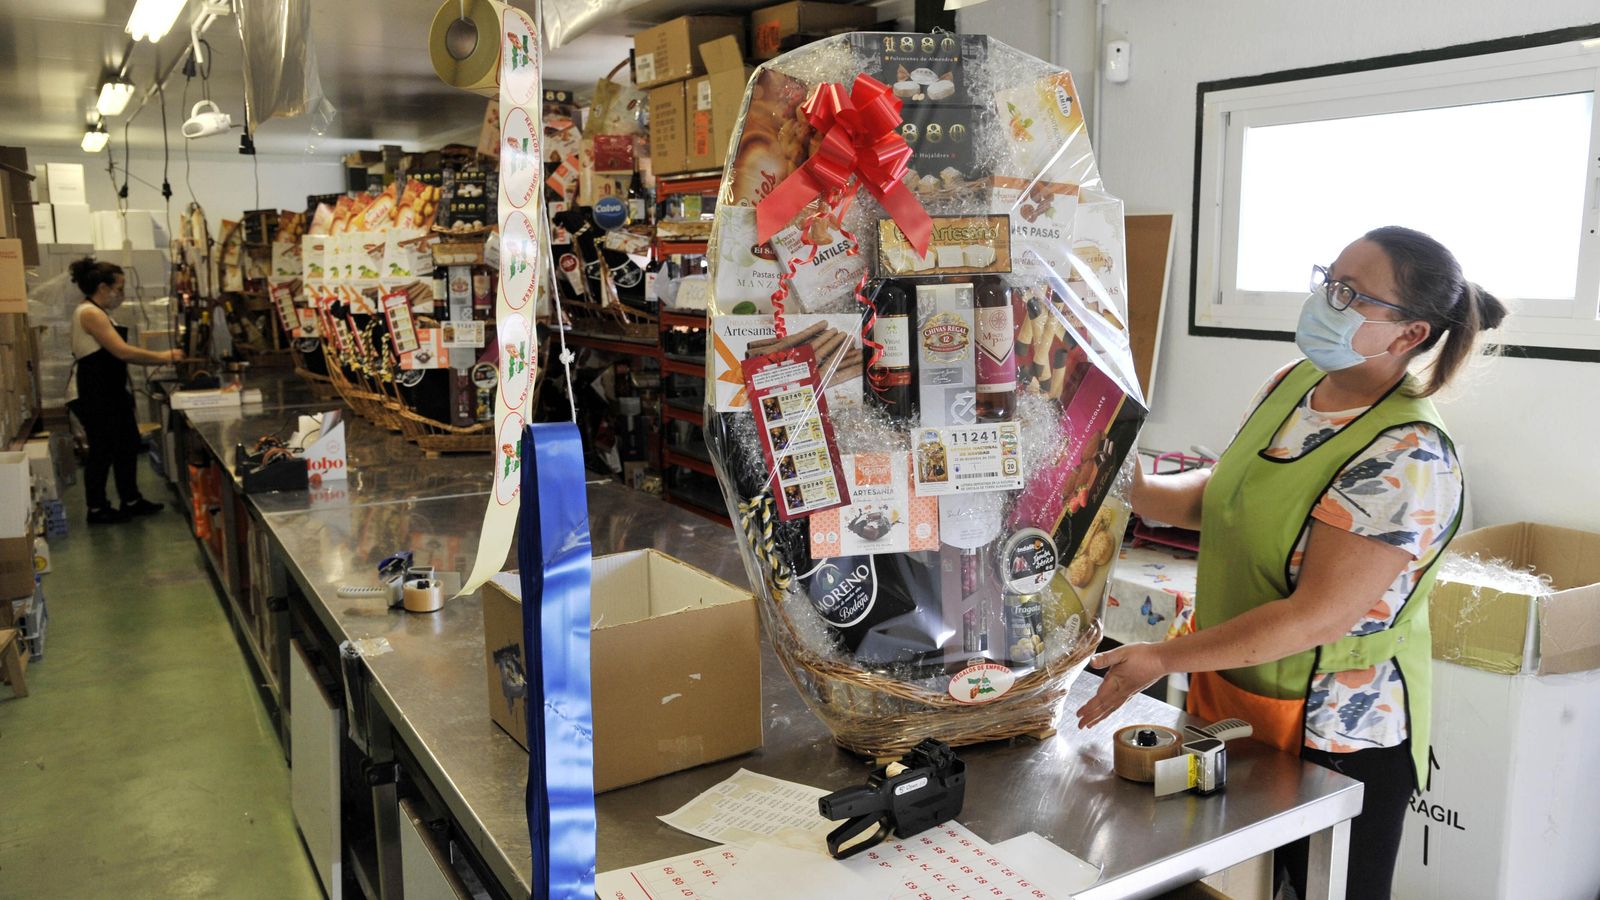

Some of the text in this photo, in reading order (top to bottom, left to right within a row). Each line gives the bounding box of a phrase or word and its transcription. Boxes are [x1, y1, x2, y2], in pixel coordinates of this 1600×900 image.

[901, 123, 966, 144] 880
[595, 205, 621, 213] Calvo
[1030, 226, 1060, 239] PASAS
[812, 239, 852, 267] DÁTILES
[752, 270, 776, 279] Pastas
[737, 279, 780, 289] MANZ
[724, 325, 777, 337] Artesanas
[924, 325, 967, 337] CHIVAS REGAL
[943, 335, 950, 343] 12
[1085, 396, 1106, 433] CHOCOLATE
[951, 430, 998, 443] 11241
[795, 451, 817, 461] 22740
[802, 480, 824, 490] 22740
[814, 564, 870, 612] MORENO
[839, 594, 869, 622] Bodega
[952, 666, 977, 683] REGALOS
[945, 830, 959, 838] 96
[958, 839, 973, 847] 95
[893, 844, 907, 853] 76
[932, 846, 946, 854] 85
[972, 848, 986, 856] 94
[722, 851, 735, 860] 29
[906, 854, 919, 862] 75
[946, 856, 960, 864] 84
[986, 858, 1000, 867] 93
[692, 859, 715, 878] 18 19
[919, 863, 933, 872] 74
[960, 865, 973, 874] 83
[1001, 868, 1015, 877] 92
[663, 866, 694, 897] 07 08 09
[932, 873, 946, 882] 73
[974, 876, 988, 885] 82
[904, 881, 918, 890] 63
[1016, 879, 1031, 887] 91
[946, 884, 960, 893] 72
[1031, 889, 1046, 898] 90
